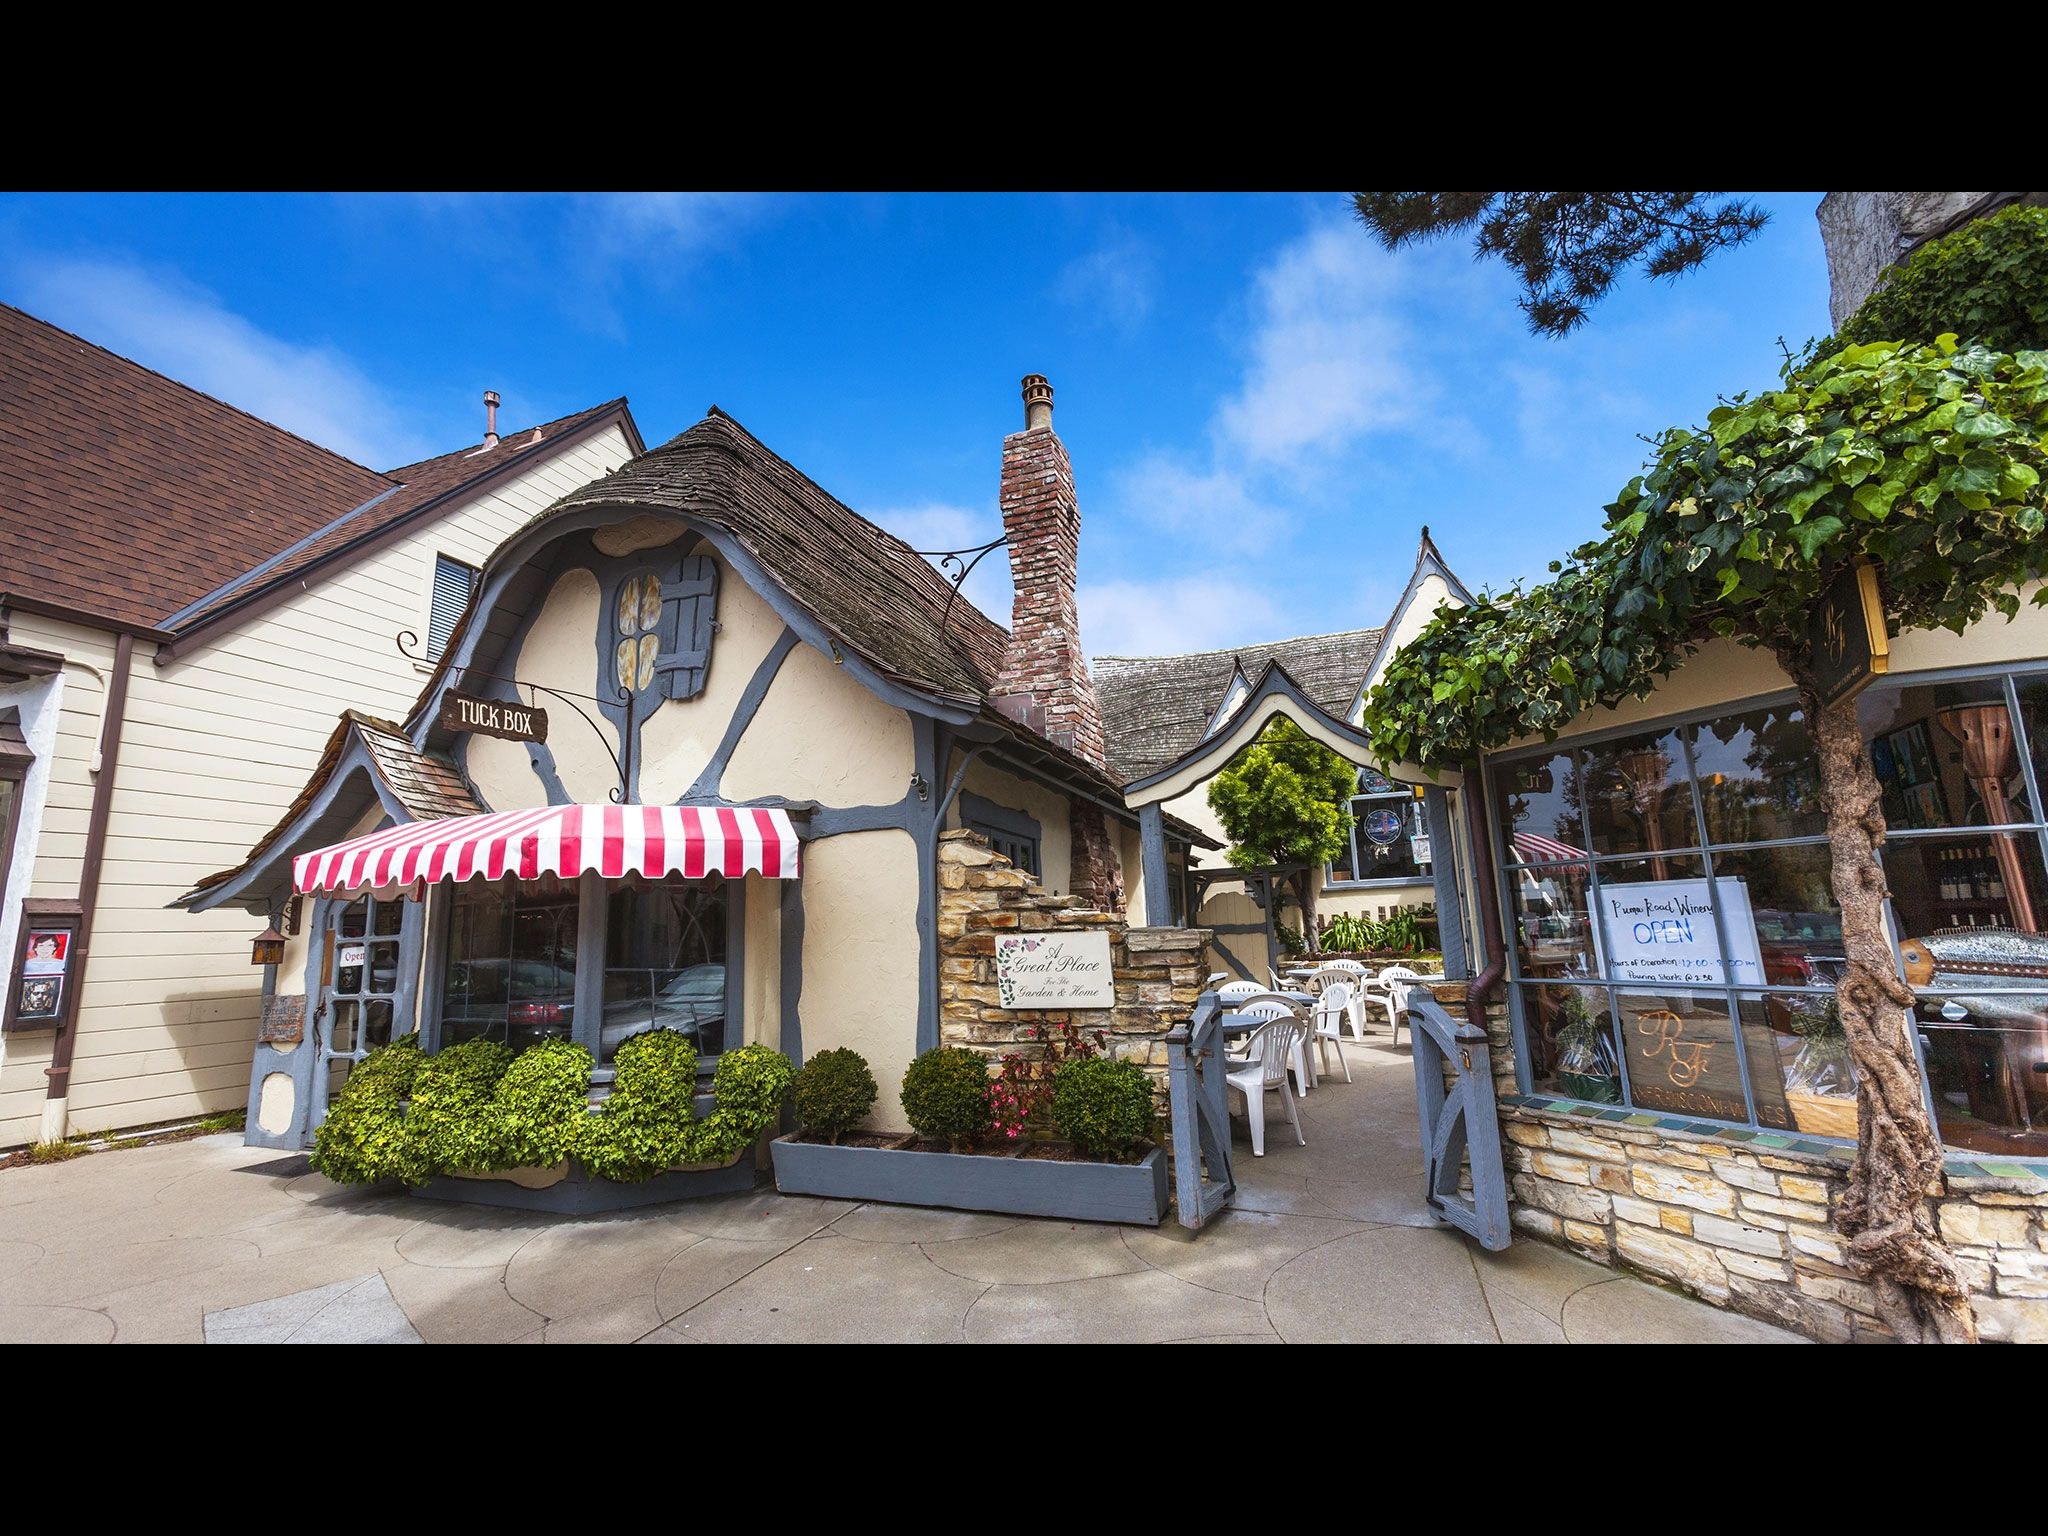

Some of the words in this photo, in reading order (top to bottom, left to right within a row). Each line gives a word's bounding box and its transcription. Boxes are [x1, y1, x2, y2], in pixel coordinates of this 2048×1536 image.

[457, 698, 501, 729] TUCK
[503, 709, 533, 735] BOX
[1611, 899, 1644, 918] Puma
[1644, 898, 1674, 917] Road
[1674, 895, 1714, 916] Winery
[1633, 918, 1694, 945] OPEN
[1045, 943, 1064, 959] A
[1012, 957, 1052, 973] Great
[1055, 955, 1100, 972] Place
[1608, 958, 1630, 968] Hours
[1631, 958, 1638, 966] of
[1627, 970, 1657, 982] Pouring
[1685, 973, 1693, 982] @
[1017, 986, 1053, 997] Garden
[1057, 988, 1066, 996] &
[1069, 985, 1099, 996] Home
